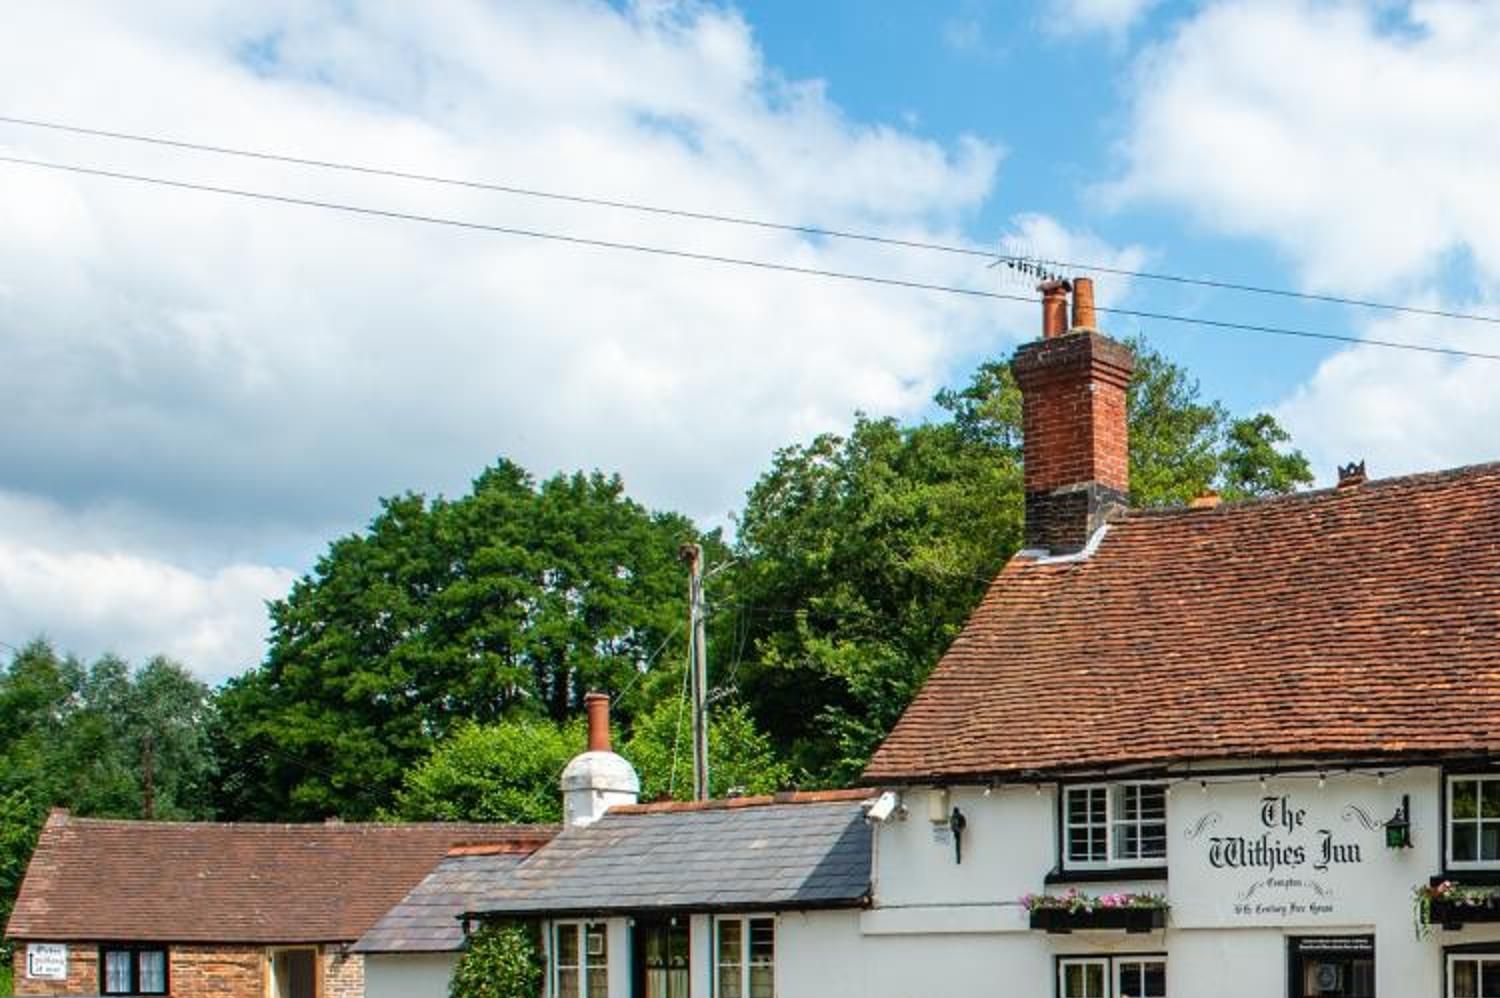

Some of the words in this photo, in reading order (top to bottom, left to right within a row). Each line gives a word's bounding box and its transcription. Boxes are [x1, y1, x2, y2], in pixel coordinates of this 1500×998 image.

[1260, 795, 1306, 835] The
[1209, 832, 1305, 872] Withies
[1313, 829, 1362, 873] Inn
[1255, 903, 1287, 917] Century
[1289, 902, 1306, 914] Free
[1309, 902, 1333, 915] House
